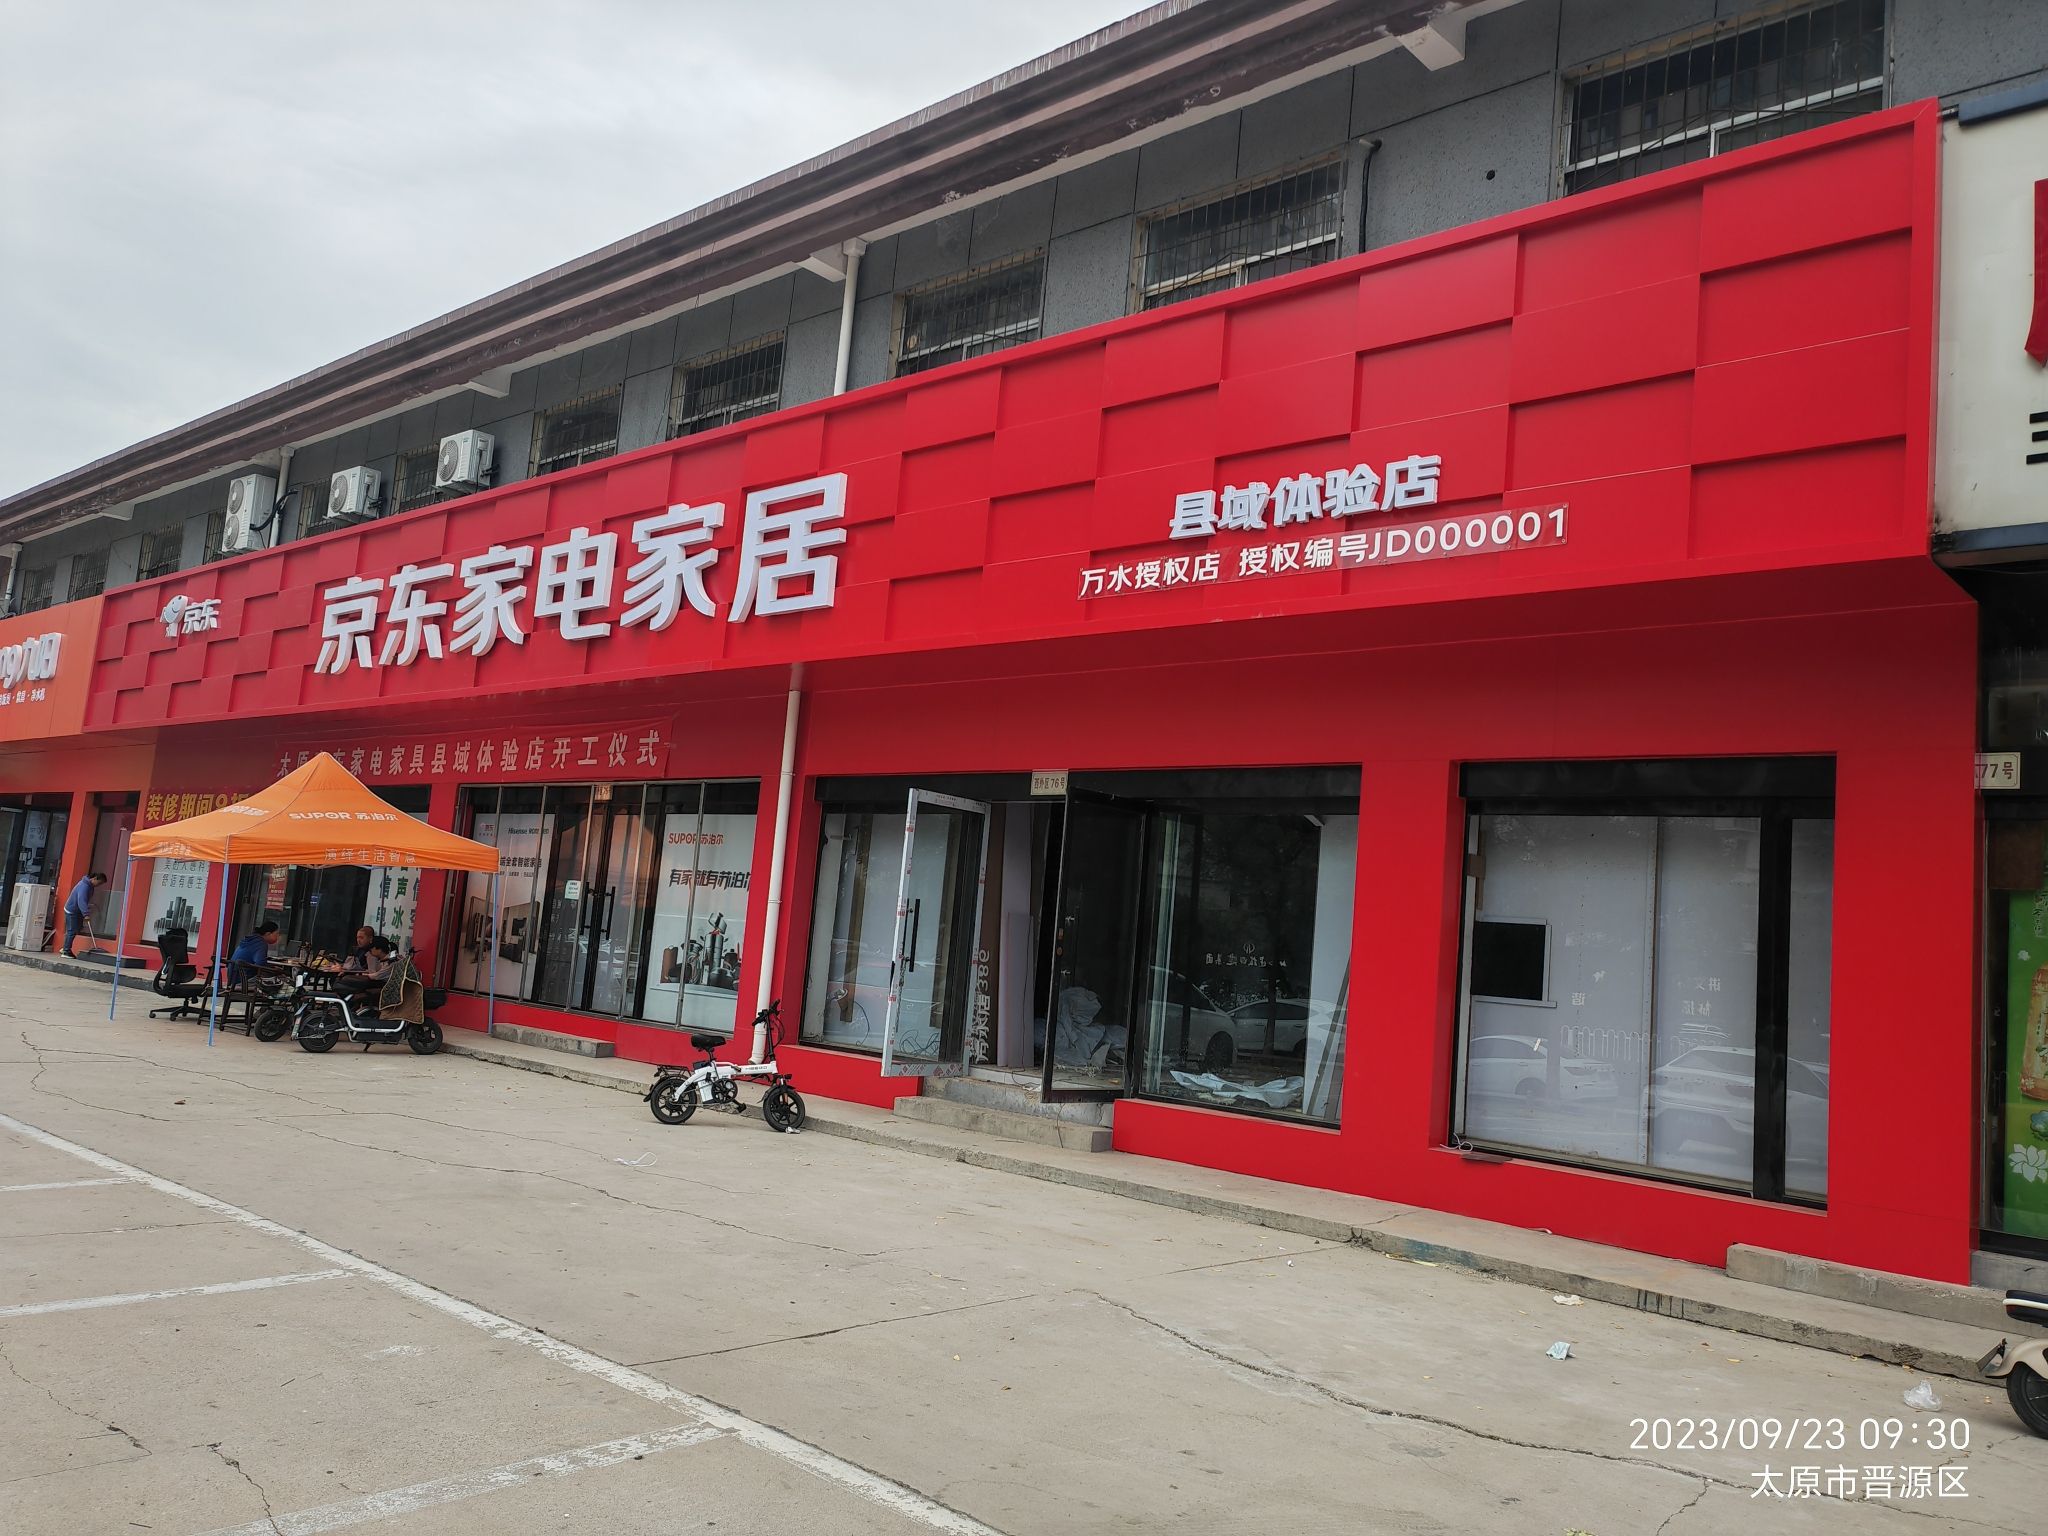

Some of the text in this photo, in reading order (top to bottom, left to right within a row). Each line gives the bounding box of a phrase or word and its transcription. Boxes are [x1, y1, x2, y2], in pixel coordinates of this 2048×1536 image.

[1169, 454, 1442, 540] 县域体验店
[314, 472, 848, 675] 京东家电家居
[1080, 508, 1565, 596] 万水授权店 授权编号JD000001
[182, 599, 222, 634] 京东
[277, 729, 660, 778] 太原东家电家具县域体验店开工仪式
[1976, 761, 2014, 780] 77号
[288, 811, 399, 821] SUPOR 苏泊尔
